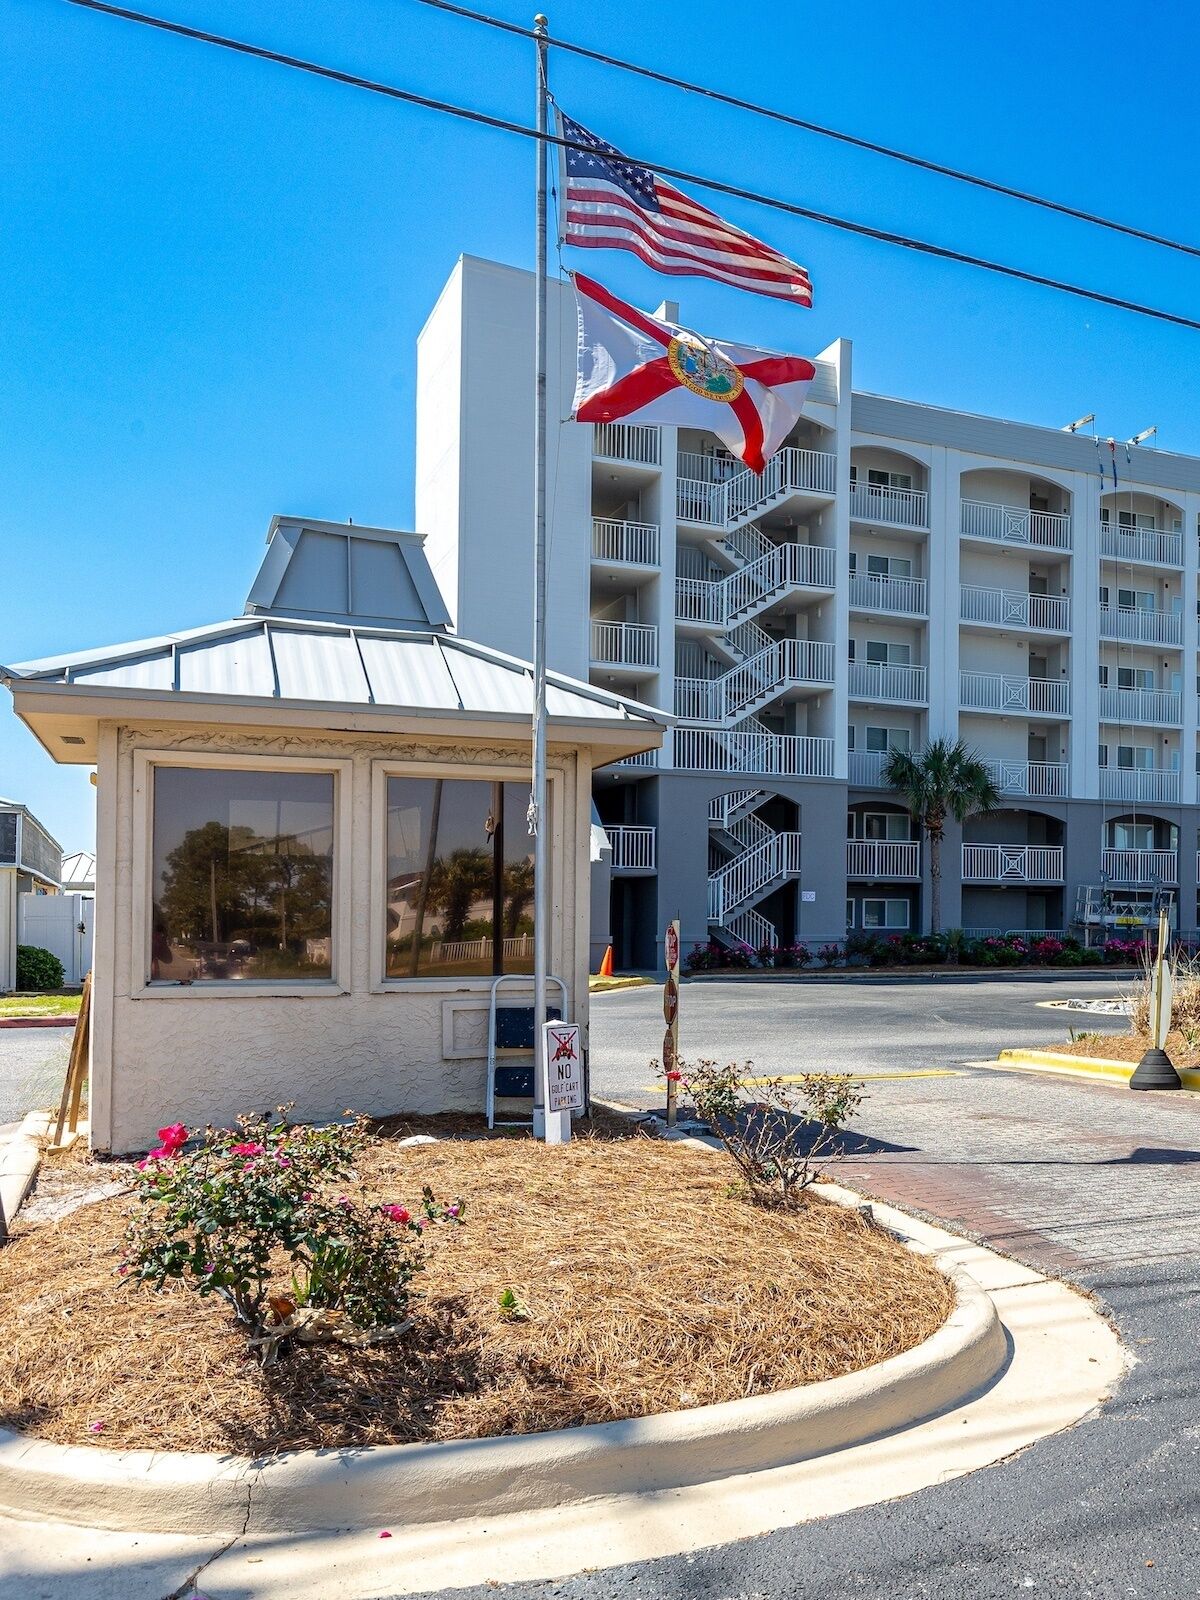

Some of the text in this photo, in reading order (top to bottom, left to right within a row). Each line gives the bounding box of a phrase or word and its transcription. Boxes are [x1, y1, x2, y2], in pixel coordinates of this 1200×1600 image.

[557, 1063, 572, 1080] NO
[551, 1081, 579, 1094] GOLF CART
[554, 1094, 577, 1107] PARKING
